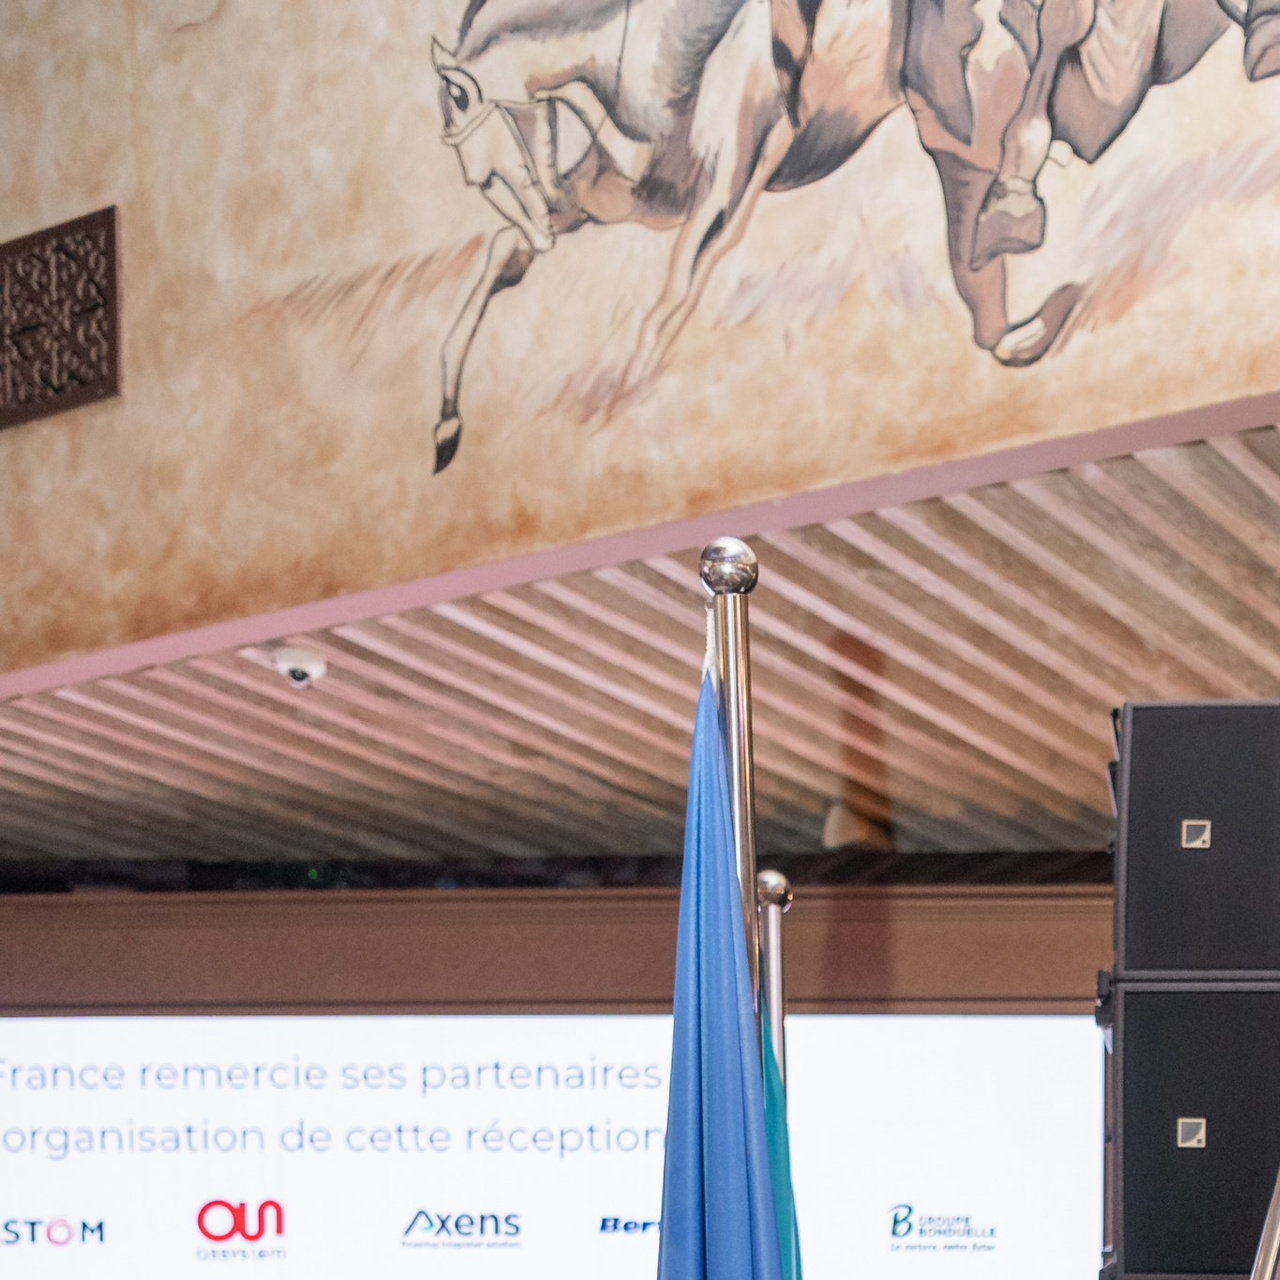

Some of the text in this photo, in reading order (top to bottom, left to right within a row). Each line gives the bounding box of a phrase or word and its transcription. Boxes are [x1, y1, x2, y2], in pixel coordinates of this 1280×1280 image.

[139, 1055, 328, 1091] remercie
[341, 1063, 407, 1090] ses
[422, 1055, 663, 1097] partenaires
[2, 1118, 666, 1160] organisation de cette réception
[403, 1210, 521, 1237] Axens
